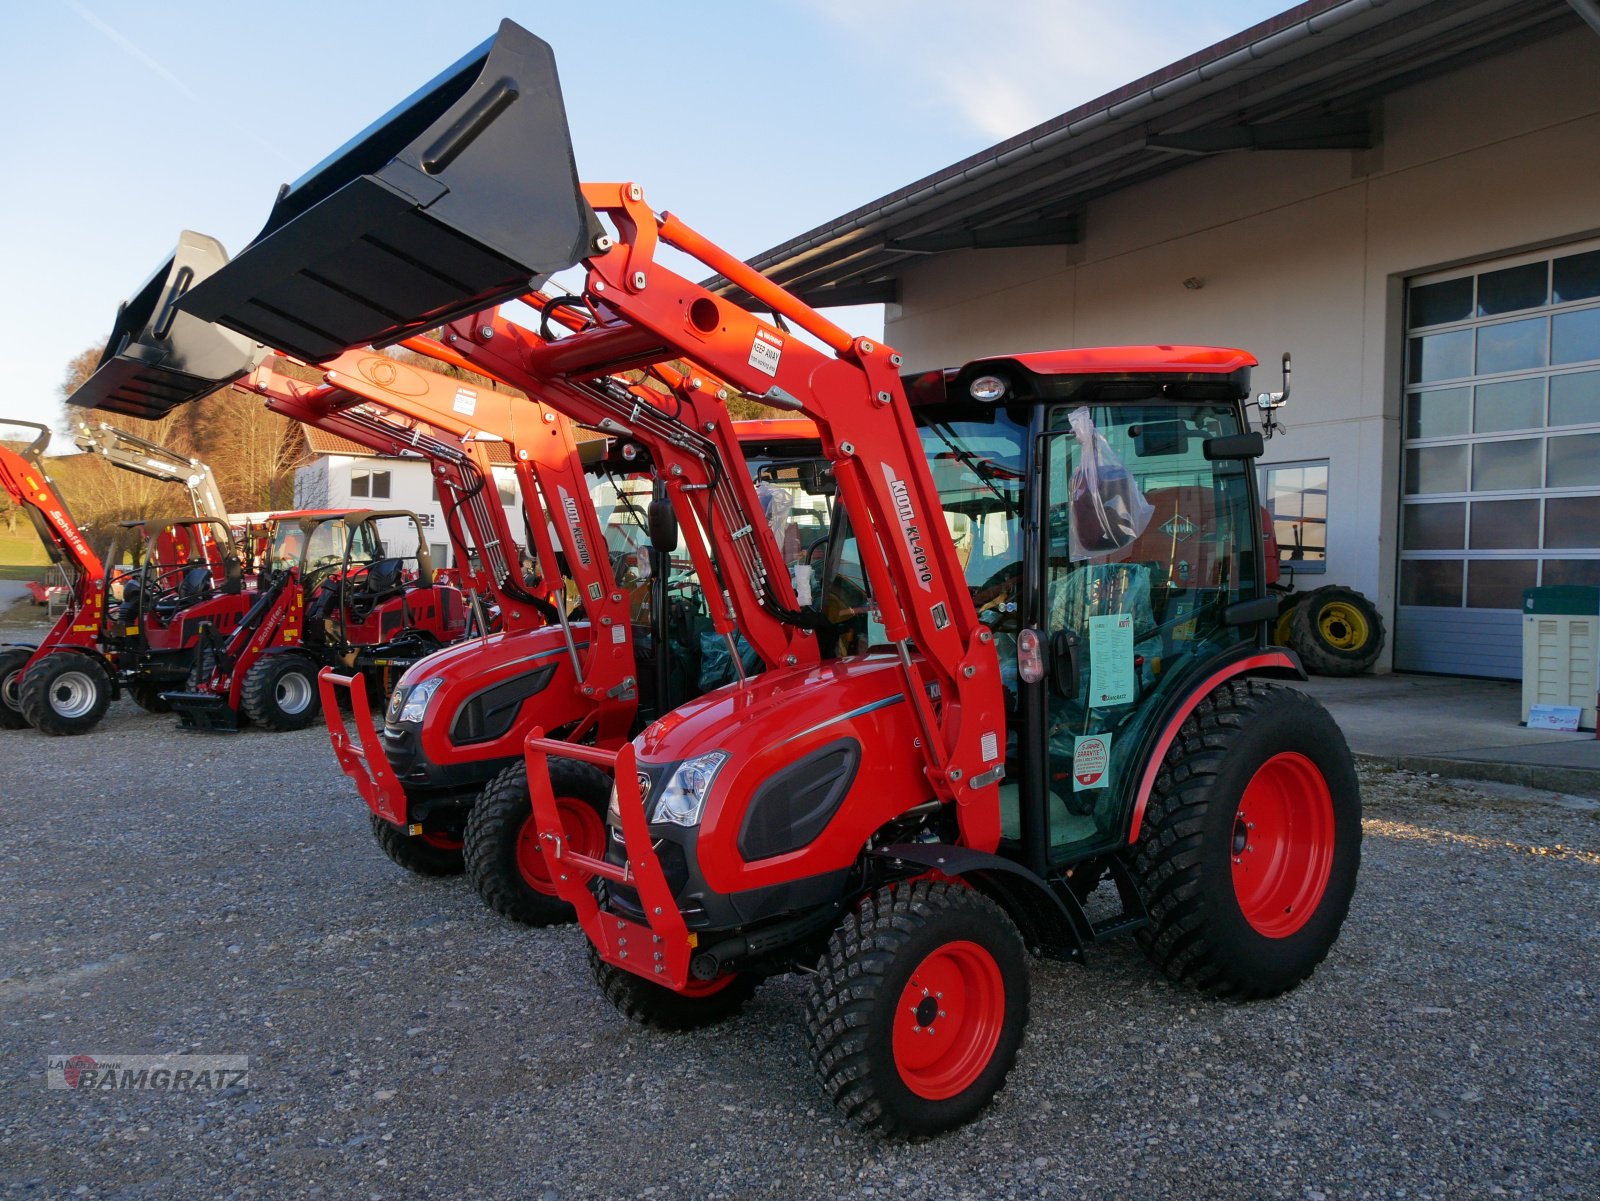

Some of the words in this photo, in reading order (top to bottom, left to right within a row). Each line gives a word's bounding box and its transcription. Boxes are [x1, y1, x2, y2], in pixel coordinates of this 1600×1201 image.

[763, 331, 784, 347] WARNING
[754, 342, 766, 355] KEEP
[765, 348, 779, 361] AWAY
